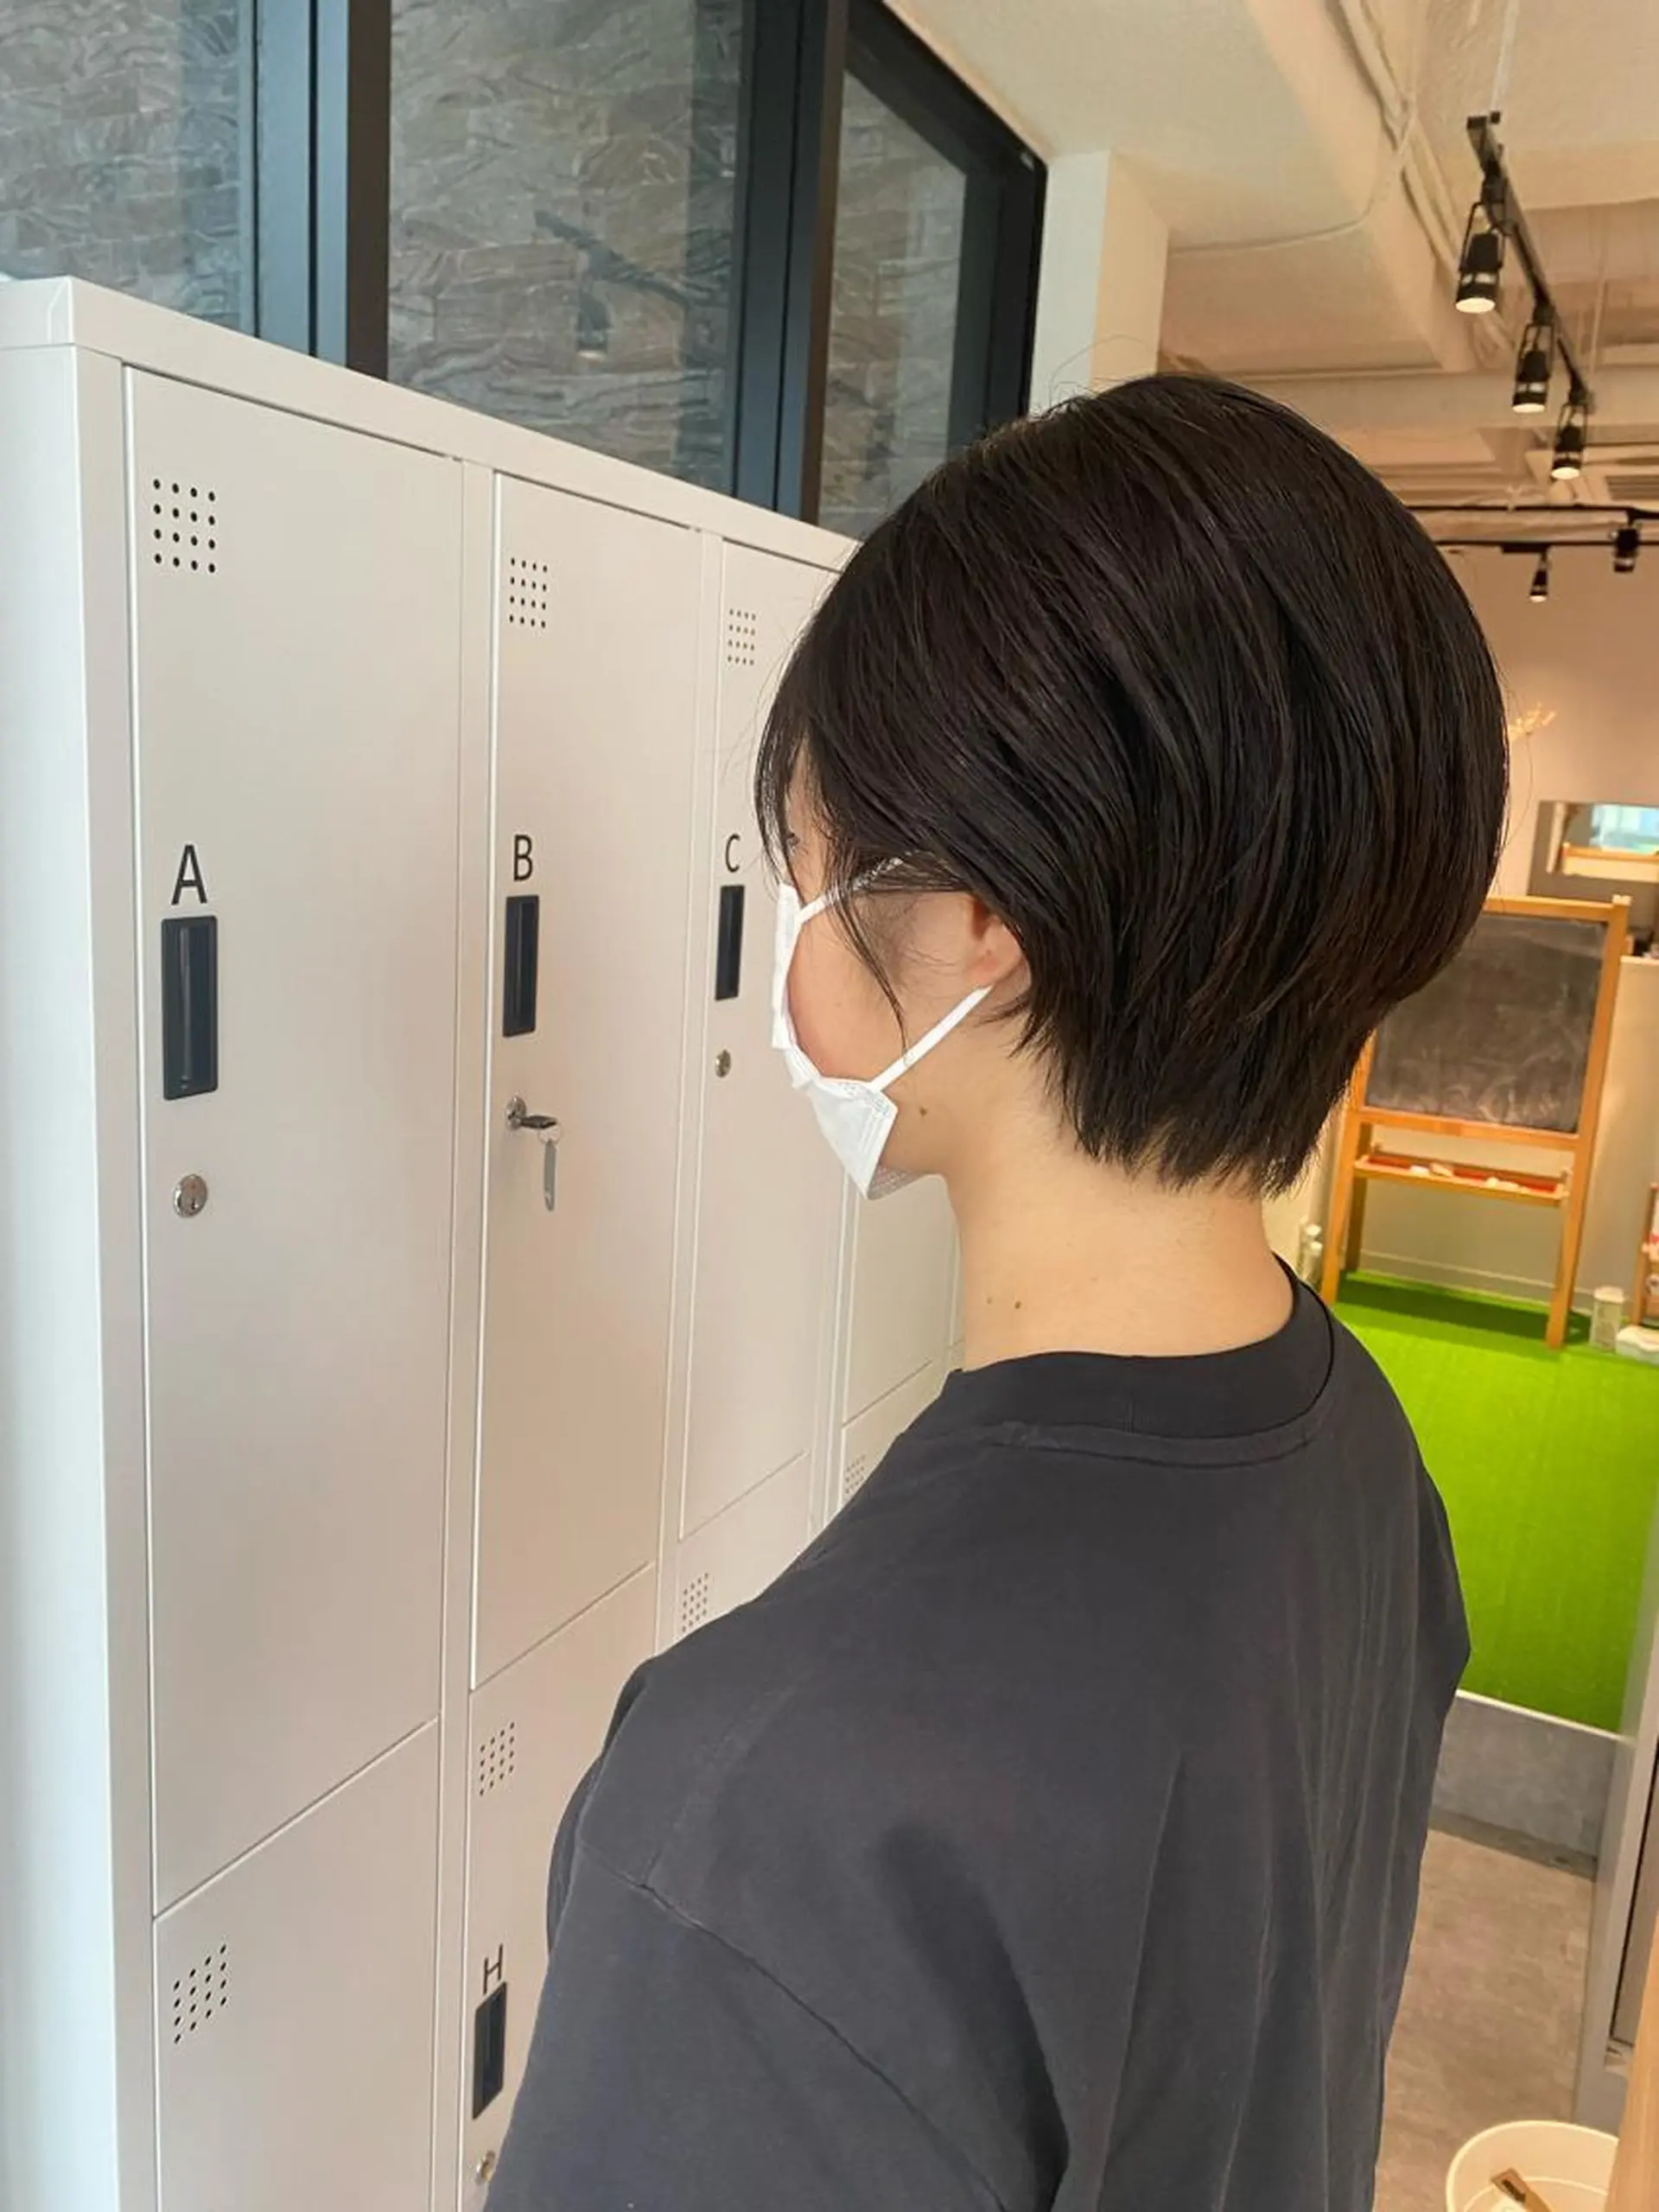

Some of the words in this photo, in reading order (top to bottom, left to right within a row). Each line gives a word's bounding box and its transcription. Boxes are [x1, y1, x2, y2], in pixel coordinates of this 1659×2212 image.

[171, 843, 207, 905] A
[512, 834, 534, 881] B
[725, 833, 741, 873] C
[482, 1943, 504, 1995] H
